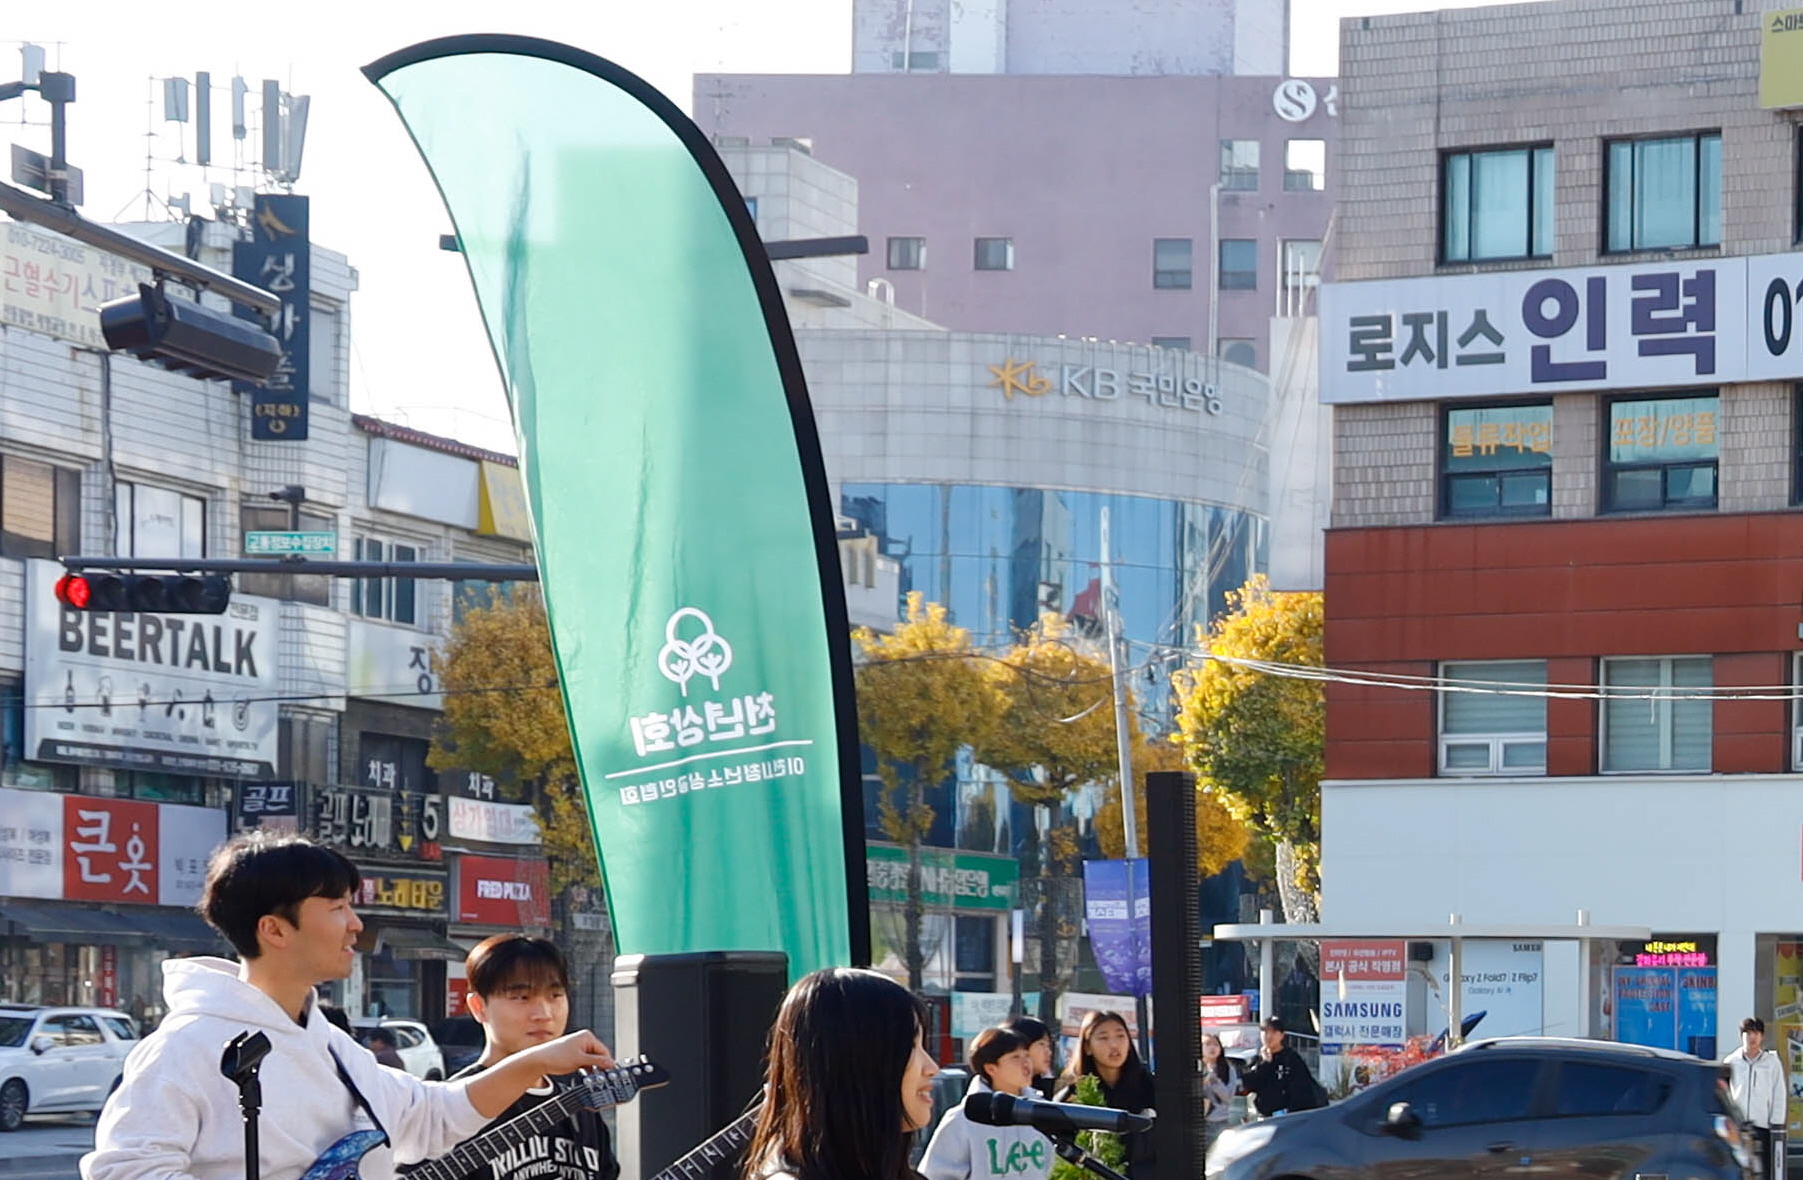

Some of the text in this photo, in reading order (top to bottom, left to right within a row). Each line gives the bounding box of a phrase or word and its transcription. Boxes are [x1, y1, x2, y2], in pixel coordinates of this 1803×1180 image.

[1347, 269, 1716, 383] 로지스 인력
[1062, 367, 1222, 416] KB 국민은행
[59, 609, 259, 679] BEERTALK
[368, 760, 396, 788] 치과
[468, 772, 495, 799] 치과
[1323, 1002, 1402, 1018] SAMSUNG
[1324, 1024, 1402, 1039] 갤럭시 전문매장
[986, 1138, 1044, 1175] Lee
